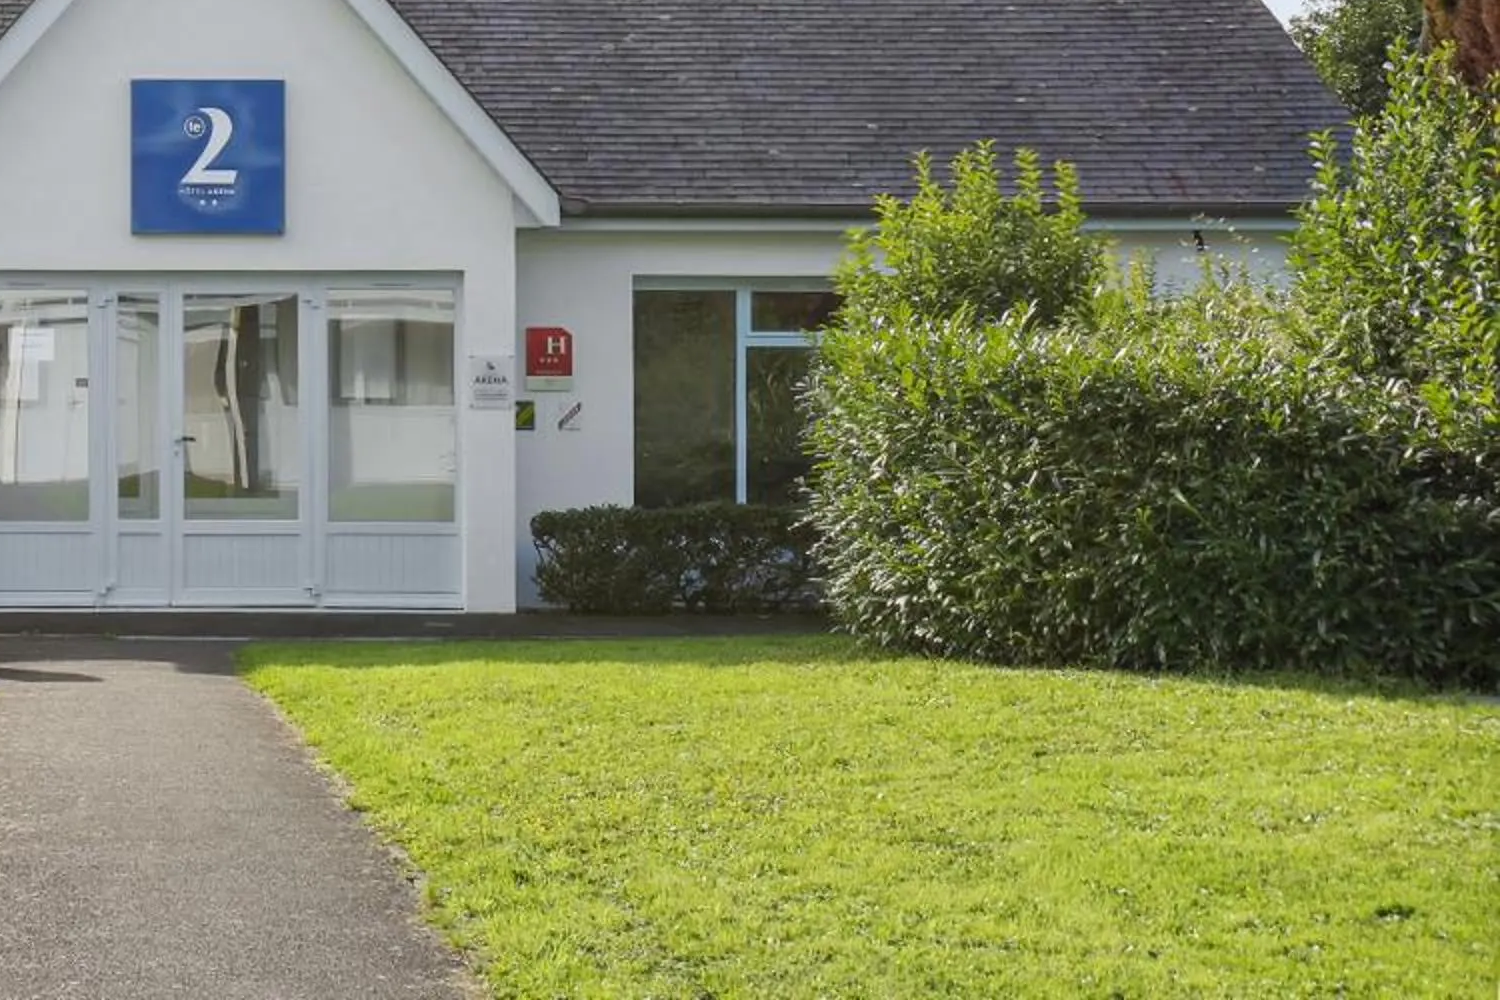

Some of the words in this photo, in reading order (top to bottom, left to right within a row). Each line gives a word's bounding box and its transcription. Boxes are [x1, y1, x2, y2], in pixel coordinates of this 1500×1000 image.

[189, 121, 201, 132] le
[180, 107, 238, 184] 2
[547, 336, 566, 354] H
